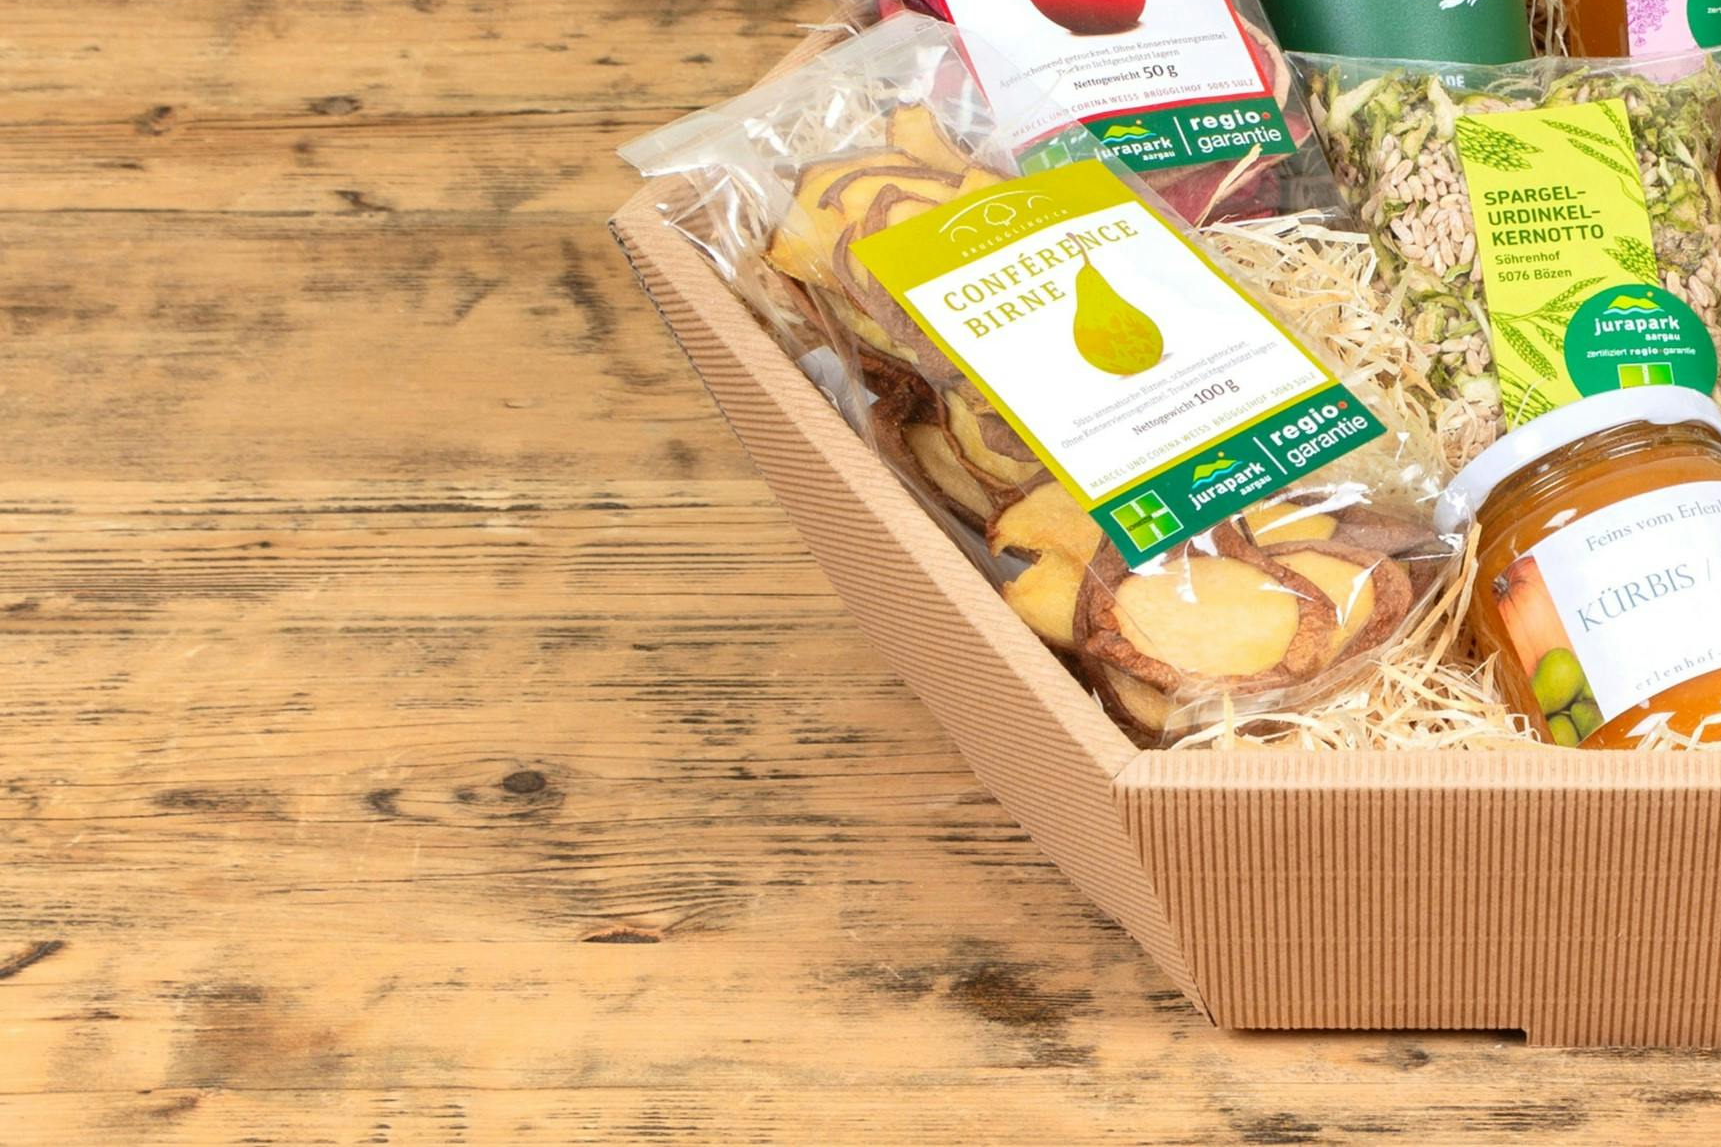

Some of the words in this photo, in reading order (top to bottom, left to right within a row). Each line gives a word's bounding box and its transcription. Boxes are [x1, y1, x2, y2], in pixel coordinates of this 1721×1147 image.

[1073, 70, 1142, 91] Nettogewicht
[1143, 63, 1165, 80] 50
[1166, 64, 1179, 78] g
[1109, 92, 1140, 105] WEISS
[1189, 108, 1262, 132] regio
[1095, 136, 1173, 163] jurapark
[1197, 124, 1283, 153] garantie
[1483, 184, 1587, 206] SPARGEL-
[1487, 203, 1602, 226] URDINKEL-
[1491, 223, 1605, 247] KERNOTTO
[943, 219, 1139, 313] CONFÉRENCE
[1494, 249, 1561, 266] Söhrenhof
[1497, 269, 1531, 283] 5076
[1533, 266, 1573, 280] Bözen
[962, 279, 1067, 340] BIRNE
[1593, 315, 1681, 337] jurapark
[1131, 398, 1197, 437] Nettogewicht
[1193, 382, 1226, 406] 100
[1225, 378, 1241, 394] g
[1268, 403, 1340, 447] regio
[1285, 414, 1370, 469] garantie
[1187, 459, 1267, 512] jurapark
[1238, 473, 1273, 497] aargau
[1584, 523, 1633, 553] Feins
[1636, 510, 1676, 533] vom
[1575, 563, 1697, 634] KÜRBIS
